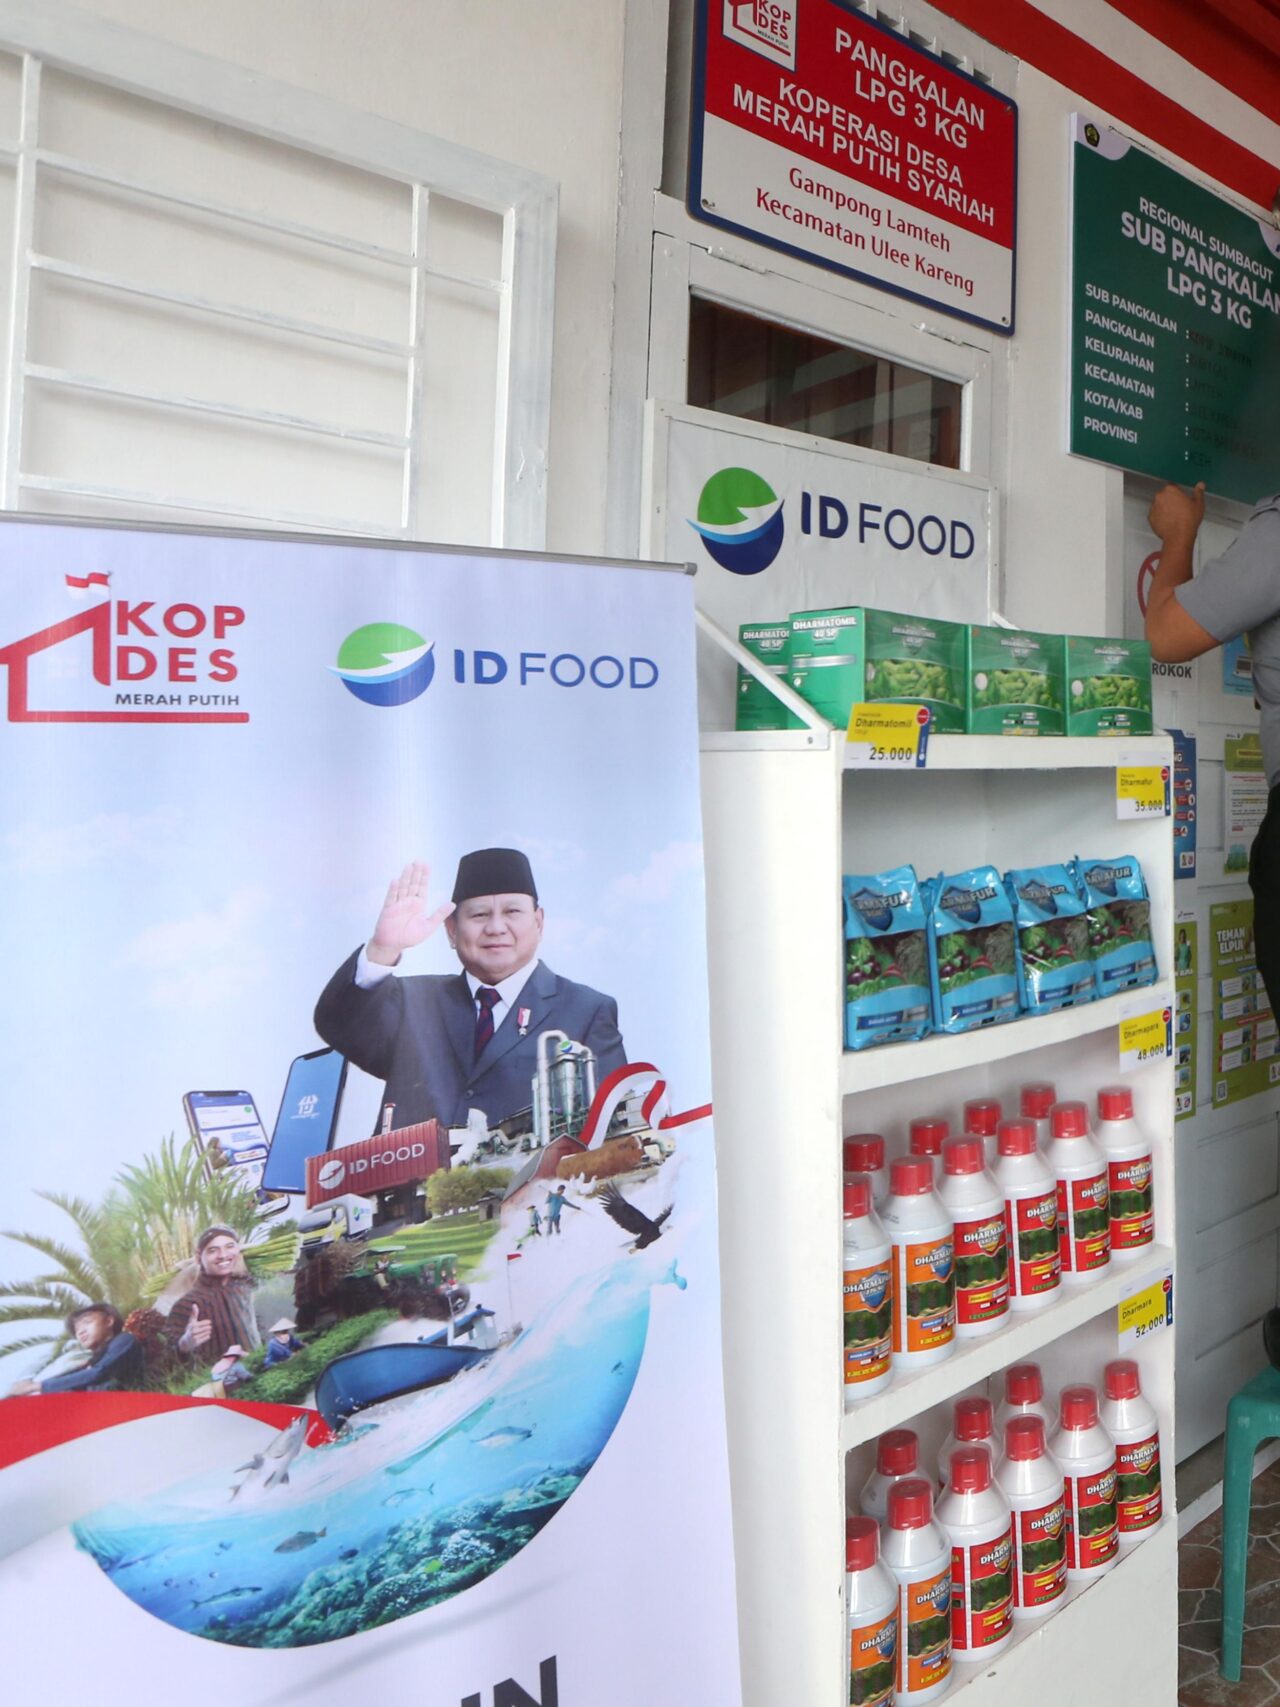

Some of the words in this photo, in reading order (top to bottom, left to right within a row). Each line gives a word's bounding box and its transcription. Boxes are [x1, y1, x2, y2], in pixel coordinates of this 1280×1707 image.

[758, 0, 791, 23] KOP
[758, 13, 788, 40] DES
[835, 27, 985, 131] PANGKALAN
[855, 70, 906, 116] LPG
[915, 103, 927, 127] 3
[935, 112, 967, 148] KG
[779, 78, 899, 156] KOPERASI
[907, 142, 963, 188] DESA
[733, 83, 824, 147] MERAH
[833, 133, 900, 182] PUTIH
[907, 169, 994, 226] SYARIAH
[789, 167, 881, 226] Gampong
[887, 209, 950, 251] Lamteh
[756, 188, 866, 250] Kecamatan
[871, 235, 910, 267] Ulee
[915, 254, 974, 296] Kareng
[1121, 211, 1167, 254] SUB
[1140, 197, 1207, 247] REGIONAL
[1209, 236, 1273, 283] SUMBAGUT
[1085, 283, 1110, 304] SUB
[1112, 294, 1177, 333] PANGKALAN
[1167, 267, 1206, 307] LPG
[1211, 289, 1222, 315] 3
[1227, 292, 1252, 329] KG
[1085, 309, 1155, 348] PANGKALAN
[1085, 336, 1154, 372] KELURAHAN
[1085, 362, 1155, 399] KECAMATAN
[1084, 389, 1143, 420] KOTA/KAB
[1084, 416, 1138, 444] PROVINSI
[801, 491, 849, 539] ID
[859, 503, 975, 560] FOOD
[117, 600, 245, 640] KOP
[793, 617, 857, 630] DHARMATOMIL
[116, 645, 238, 683] DES
[454, 648, 507, 686] ID
[519, 652, 659, 690] FOOD
[1152, 663, 1193, 679] ROKOK
[115, 692, 182, 706] MERAH
[189, 694, 240, 706] PUTIH
[855, 717, 912, 728] Dharmatomil
[869, 747, 913, 761] 25.000
[1135, 800, 1163, 812] 35.000
[1137, 1043, 1164, 1061] 48.000
[350, 1158, 368, 1175] ID
[370, 1143, 425, 1167] FOOD
[1136, 1313, 1164, 1338] 52.000
